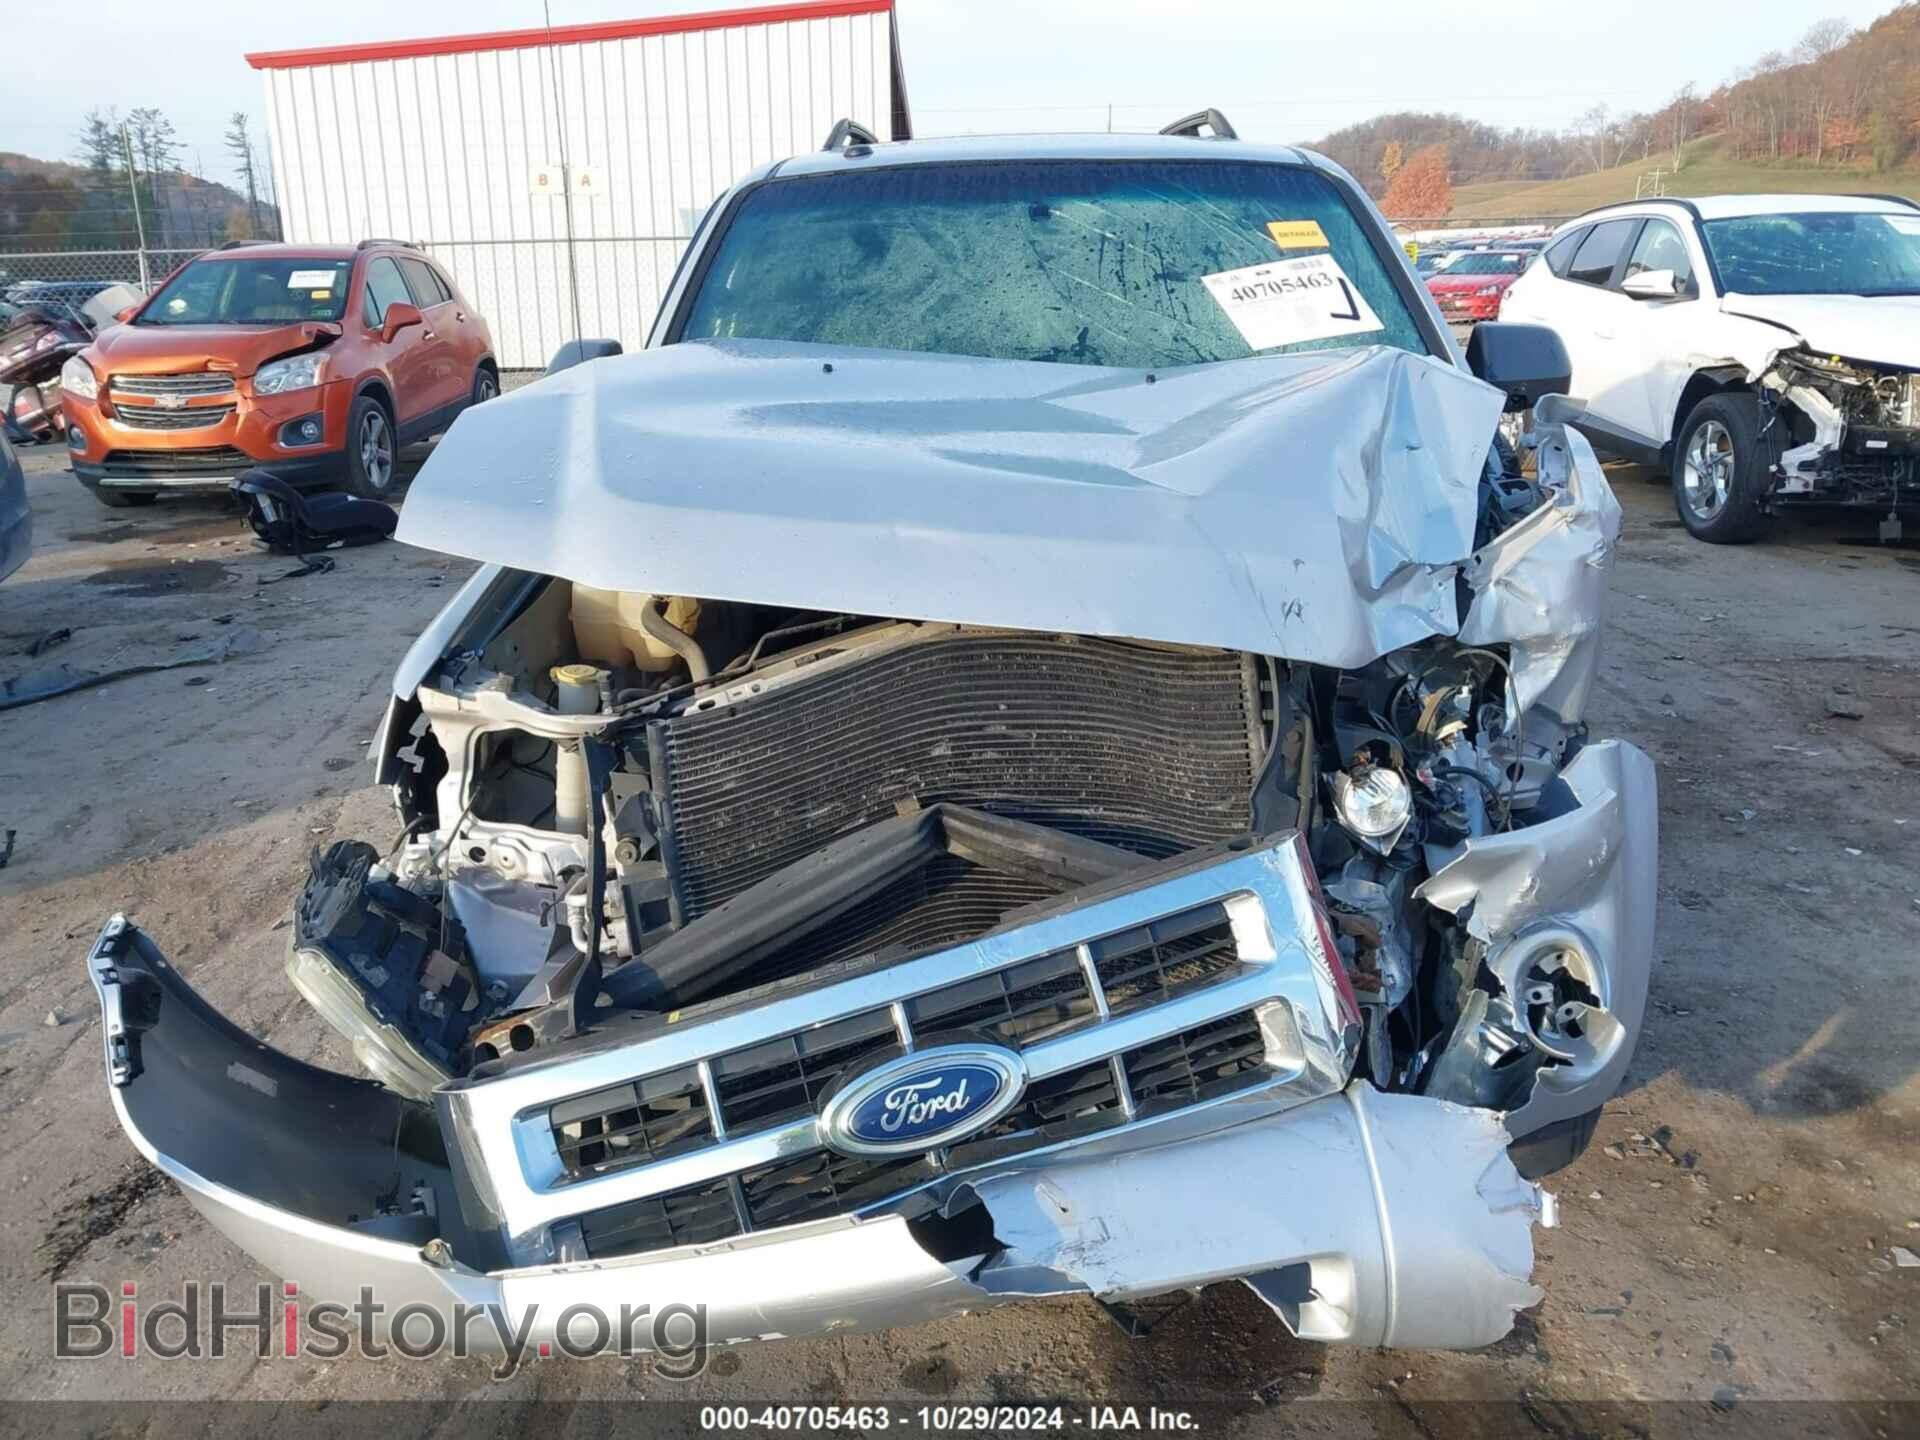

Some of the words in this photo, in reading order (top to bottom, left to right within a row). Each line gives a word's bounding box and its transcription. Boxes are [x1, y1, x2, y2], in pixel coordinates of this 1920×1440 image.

[538, 174, 548, 186] B
[581, 174, 591, 187] A
[1231, 271, 1333, 302] 40705463
[880, 1076, 970, 1132] Ford
